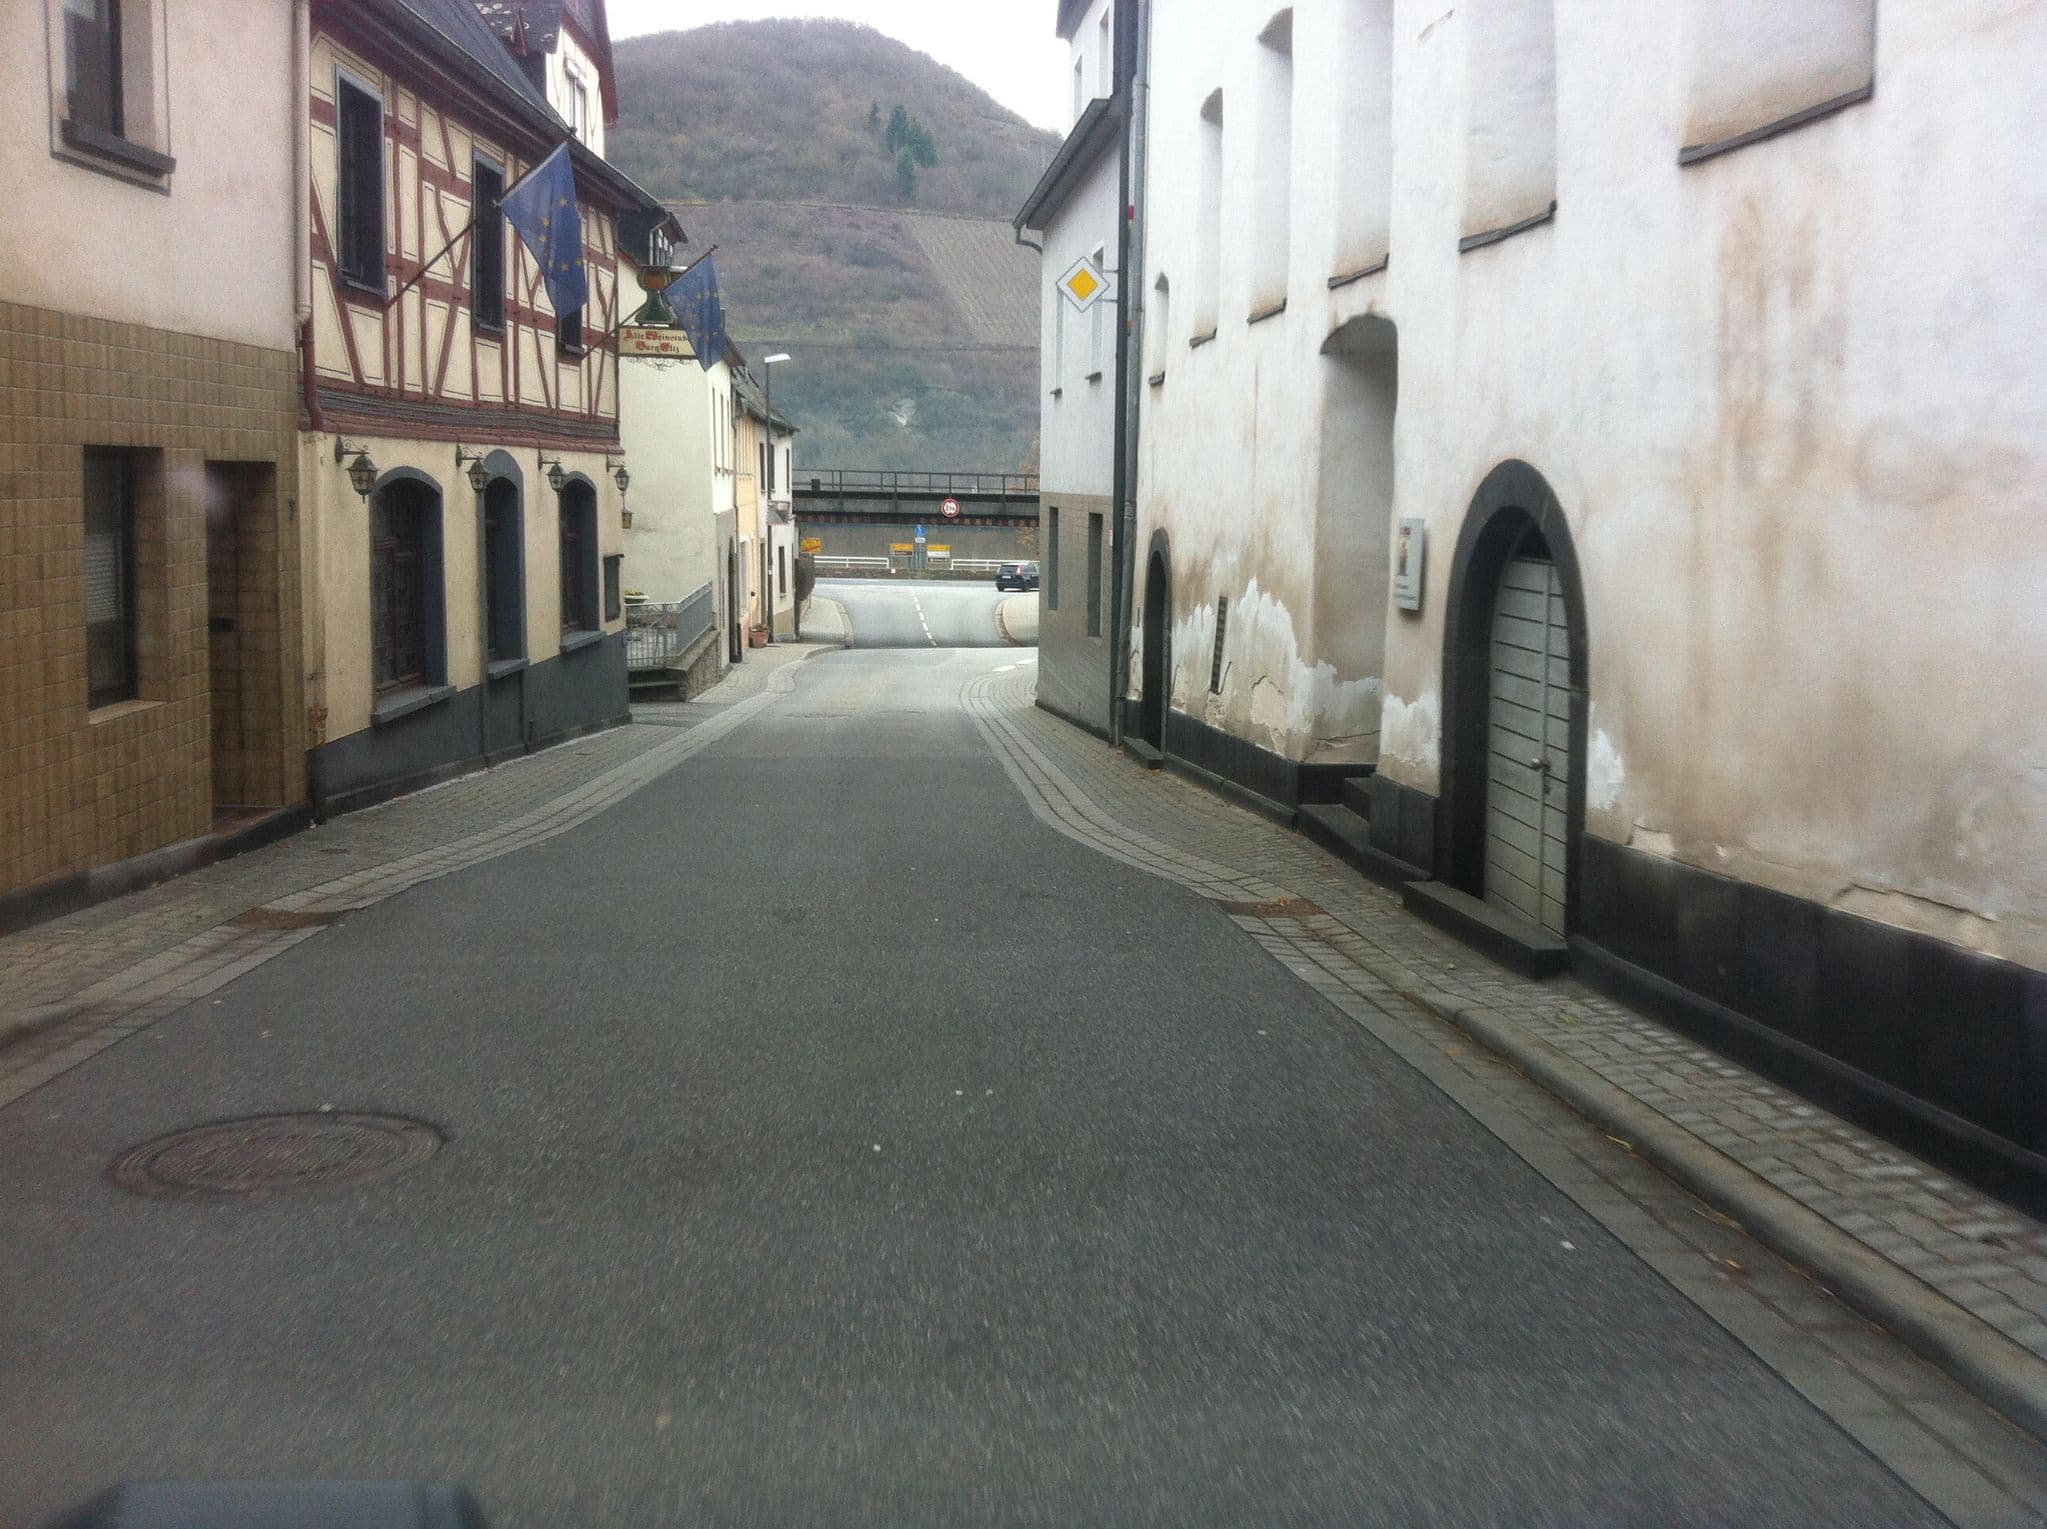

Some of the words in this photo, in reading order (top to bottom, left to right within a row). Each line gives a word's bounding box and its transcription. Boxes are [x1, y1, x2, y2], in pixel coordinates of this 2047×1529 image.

[624, 329, 645, 341] Alte
[645, 331, 688, 342] Weinstub
[635, 341, 659, 352] Burg
